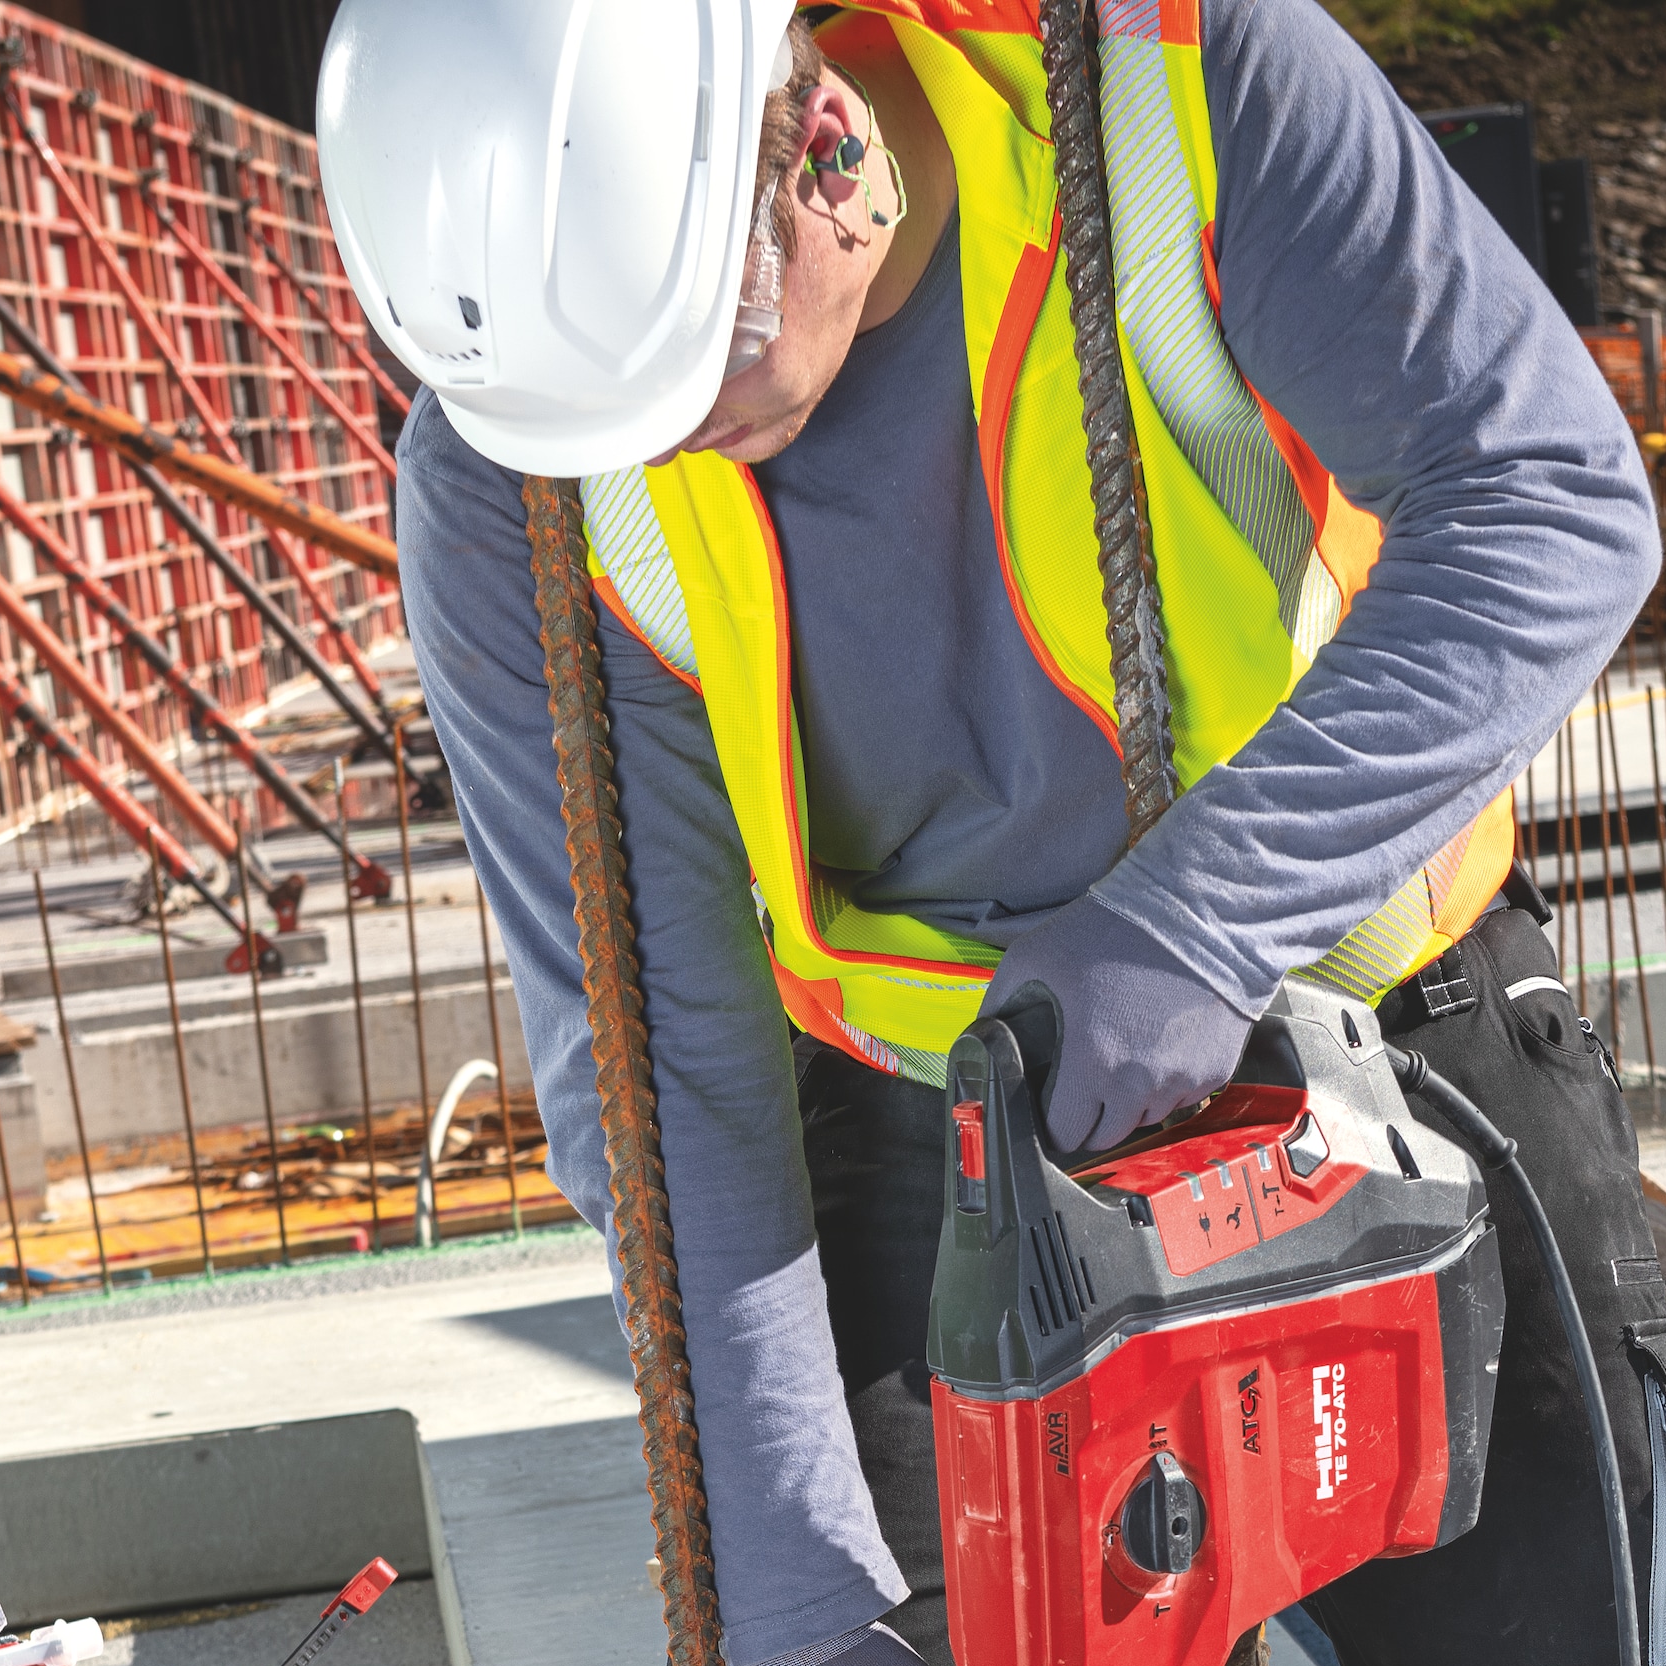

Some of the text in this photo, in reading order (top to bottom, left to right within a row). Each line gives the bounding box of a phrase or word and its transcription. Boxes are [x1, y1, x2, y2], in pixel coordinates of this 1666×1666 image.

[1046, 1411, 1065, 1457] AVR
[1312, 1365, 1334, 1500] HILTI
[1332, 1362, 1348, 1486] TE 70-ATC
